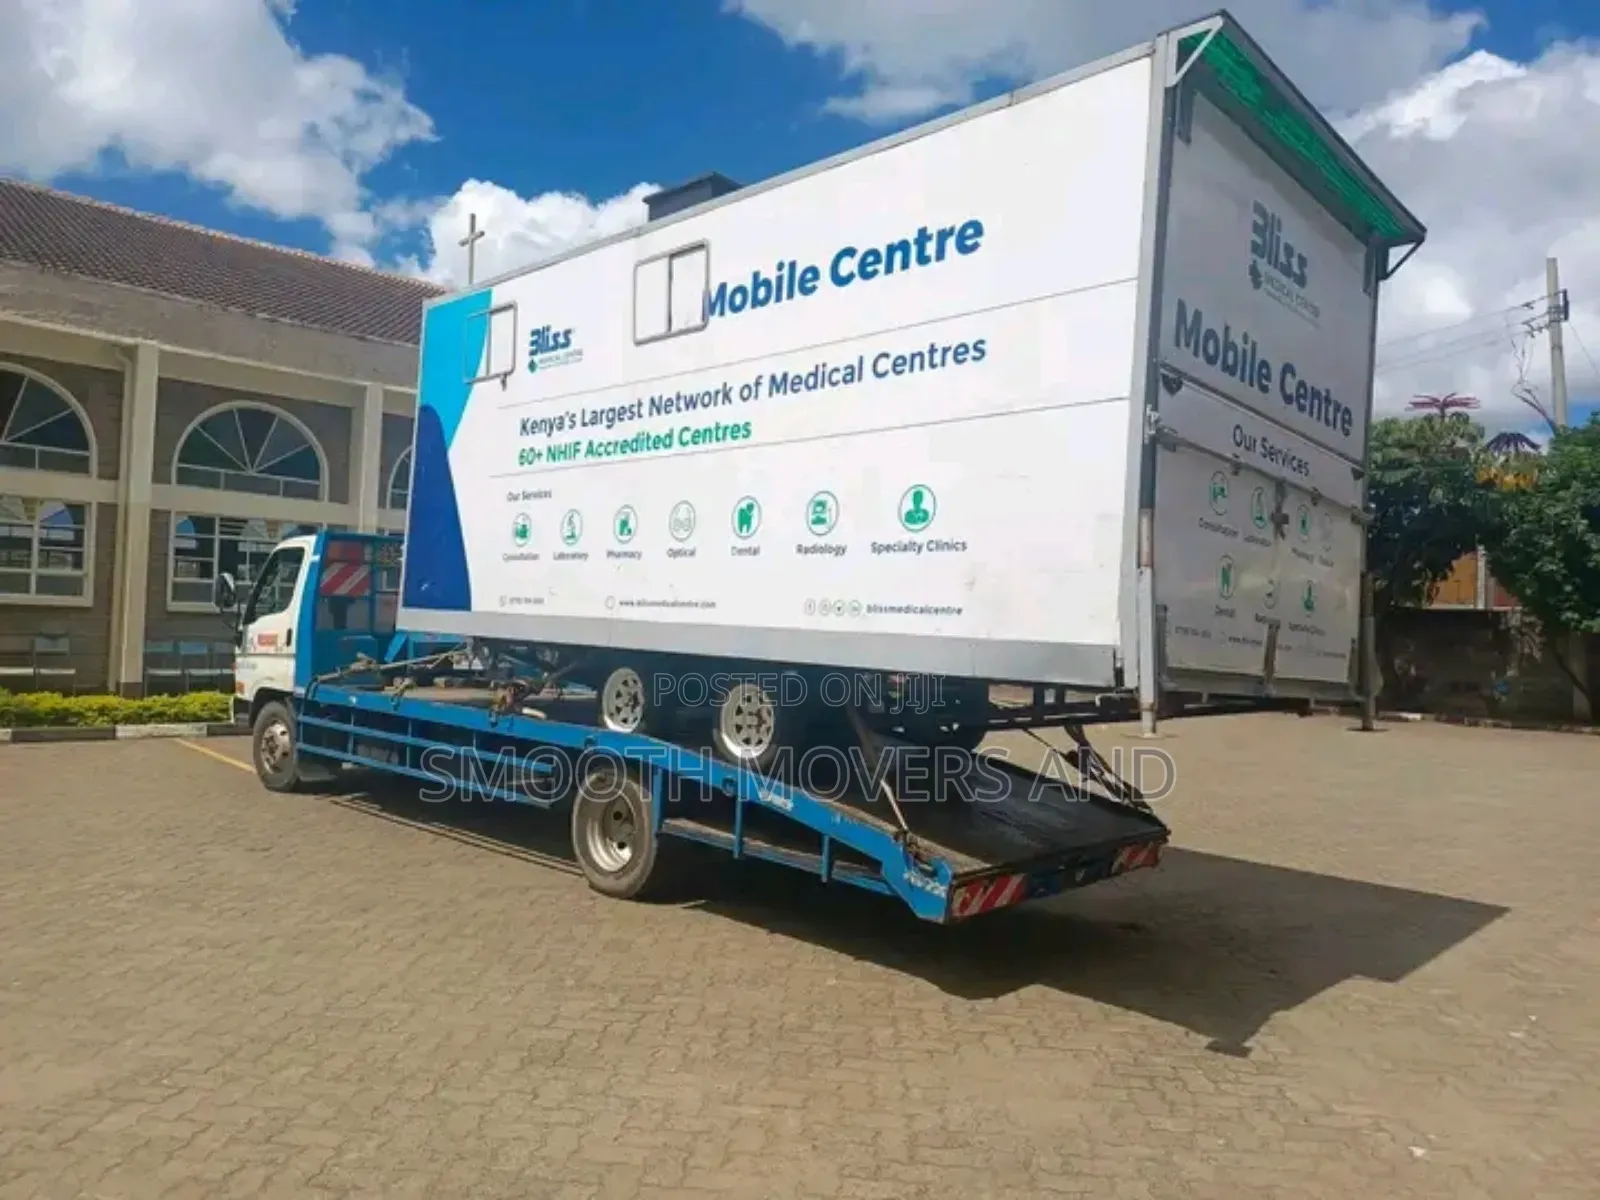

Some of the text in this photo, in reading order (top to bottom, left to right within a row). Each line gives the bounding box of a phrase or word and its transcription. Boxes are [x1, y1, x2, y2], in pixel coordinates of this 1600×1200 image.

[701, 219, 985, 318] Mobile Centre
[1174, 297, 1273, 395] Mobile
[1279, 362, 1352, 438] Centre
[519, 338, 987, 438] Kenya's Largest Network of Medical Centres
[518, 420, 752, 467] 60+ NHIF Accredited Centres
[1232, 424, 1310, 477] Our Services
[506, 489, 552, 502] Our Services
[606, 549, 643, 561] Pharmacy
[666, 547, 696, 560] Optical
[730, 545, 761, 557] Dental
[796, 543, 847, 557] Radiology
[870, 539, 968, 556] Specialty Clinics
[866, 602, 964, 616] blissmedicalcentre
